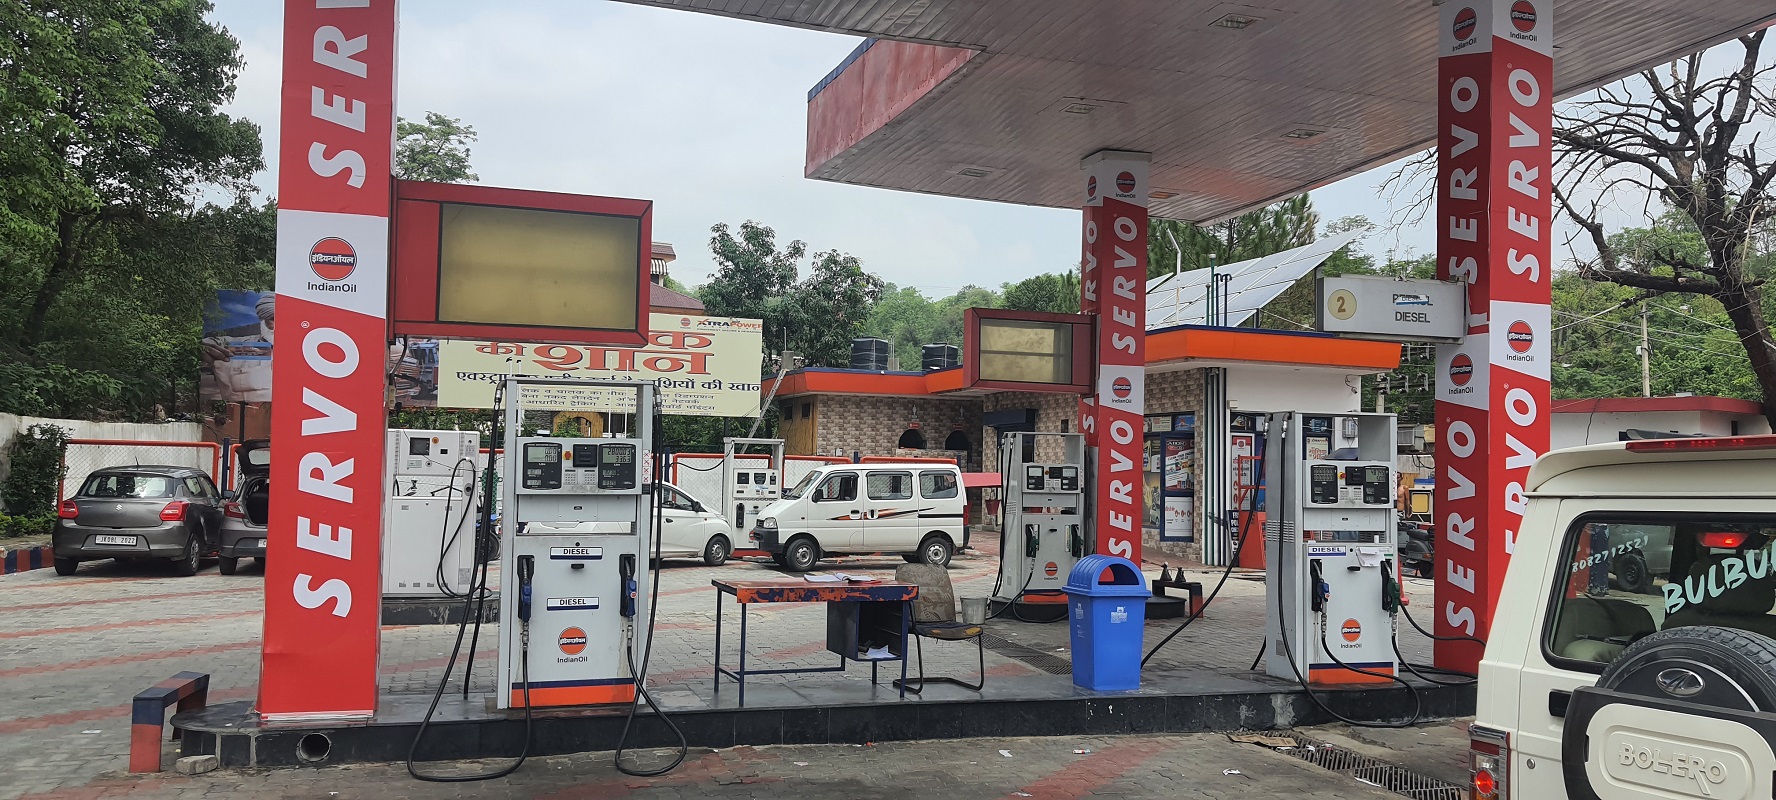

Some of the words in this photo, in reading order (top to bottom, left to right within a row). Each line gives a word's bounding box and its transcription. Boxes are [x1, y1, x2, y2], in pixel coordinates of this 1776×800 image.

[1452, 37, 1477, 52] IndianOil
[1509, 31, 1537, 41] IndianOil
[308, 0, 370, 189] SER
[1449, 76, 1480, 285] SERVO
[1507, 68, 1540, 284] SERVO
[307, 281, 357, 293] IndianOil
[1111, 216, 1138, 355] SERVO
[1336, 296, 1346, 313] 2
[1395, 311, 1431, 324] DIESEL
[532, 344, 715, 375] शान
[700, 380, 722, 390] की
[1448, 387, 1474, 395] IndianOil
[293, 327, 360, 618] SERVO
[1108, 419, 1134, 560] SERVO
[1446, 420, 1476, 637] SERVO
[1619, 742, 1727, 796] BOLERO
